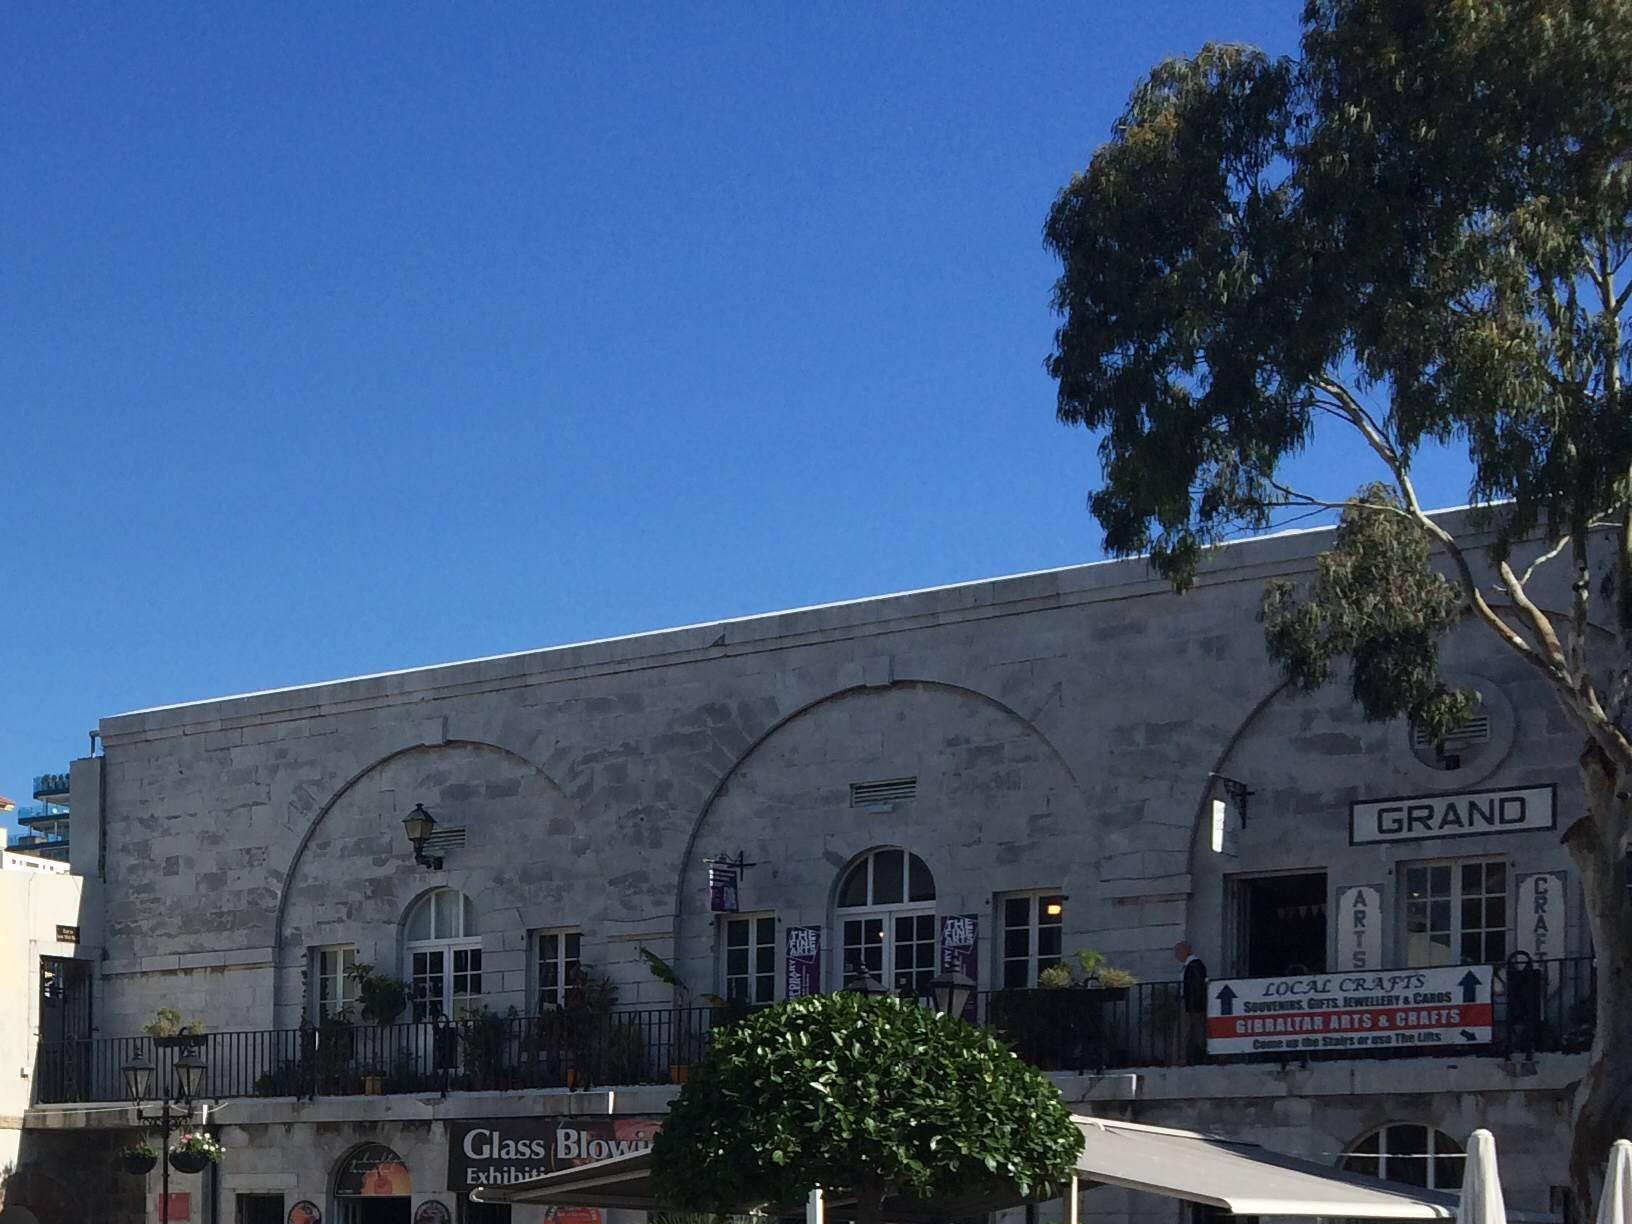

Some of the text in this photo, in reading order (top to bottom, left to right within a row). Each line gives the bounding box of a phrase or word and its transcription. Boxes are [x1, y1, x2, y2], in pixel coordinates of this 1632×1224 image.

[1377, 796, 1527, 834] GRAND
[944, 928, 973, 938] FINE
[947, 919, 973, 930] THE
[1352, 889, 1367, 968] ARTS
[791, 929, 817, 941] THE
[944, 936, 973, 946] ARTS
[789, 939, 817, 949] FINE
[789, 947, 817, 956] ARTS
[1262, 974, 1426, 997] LOCAL CRAFTS
[1343, 995, 1400, 1008] JEWELLERY
[1402, 996, 1411, 1005] &
[1413, 991, 1452, 1004] CARDS
[1236, 1008, 1461, 1034] GIBRALTAR ARTS & CRAFTS
[1253, 1031, 1442, 1050] Come up the Stairs or use The Lifts
[463, 1128, 545, 1160] Glass
